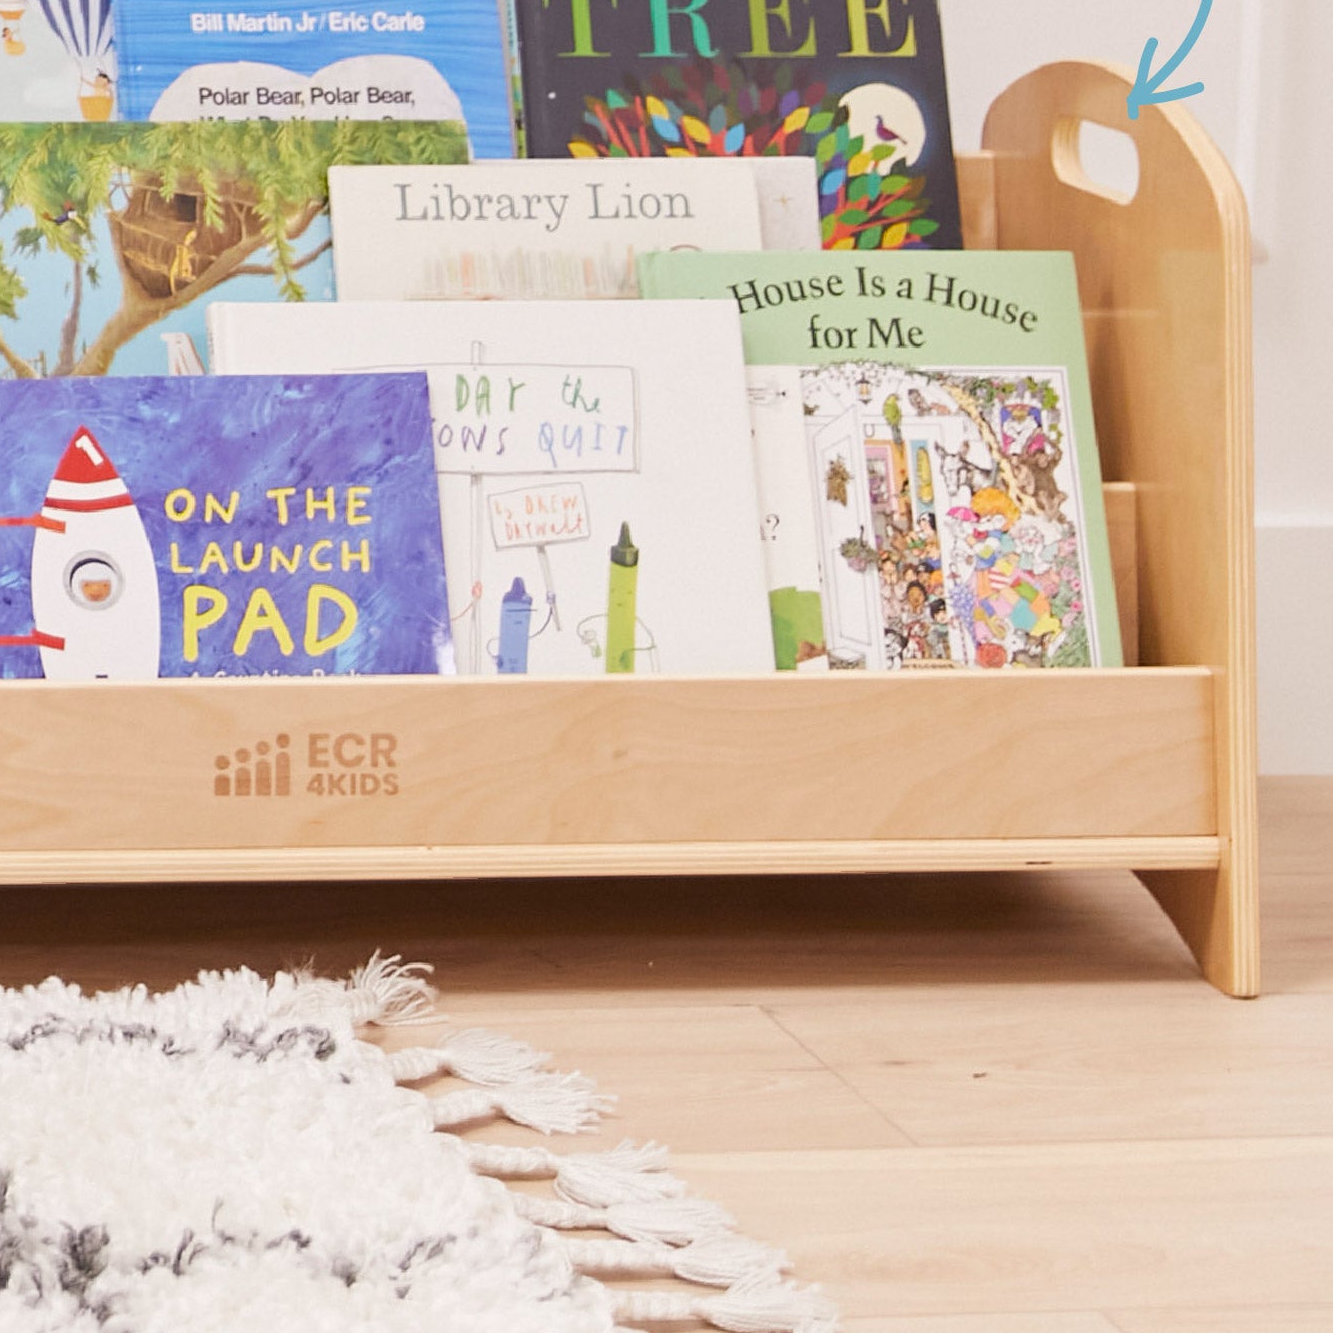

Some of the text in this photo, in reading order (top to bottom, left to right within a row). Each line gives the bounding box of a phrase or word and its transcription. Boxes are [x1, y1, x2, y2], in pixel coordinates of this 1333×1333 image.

[191, 13, 222, 31] Bill
[227, 13, 292, 31] Martin
[372, 11, 425, 31] Carle
[199, 87, 415, 108] Polar Bear, Polar Bear,
[394, 183, 694, 232] Library Lion
[728, 267, 1038, 333] House Is a House
[808, 314, 926, 349] for Me
[456, 374, 600, 416] DAY the
[538, 422, 628, 468] QUIT
[165, 487, 372, 525] ON THE
[170, 539, 370, 574] LAUNCH
[183, 584, 358, 663] PAD
[307, 733, 398, 768] ECR
[306, 773, 400, 796] 4KIDS
